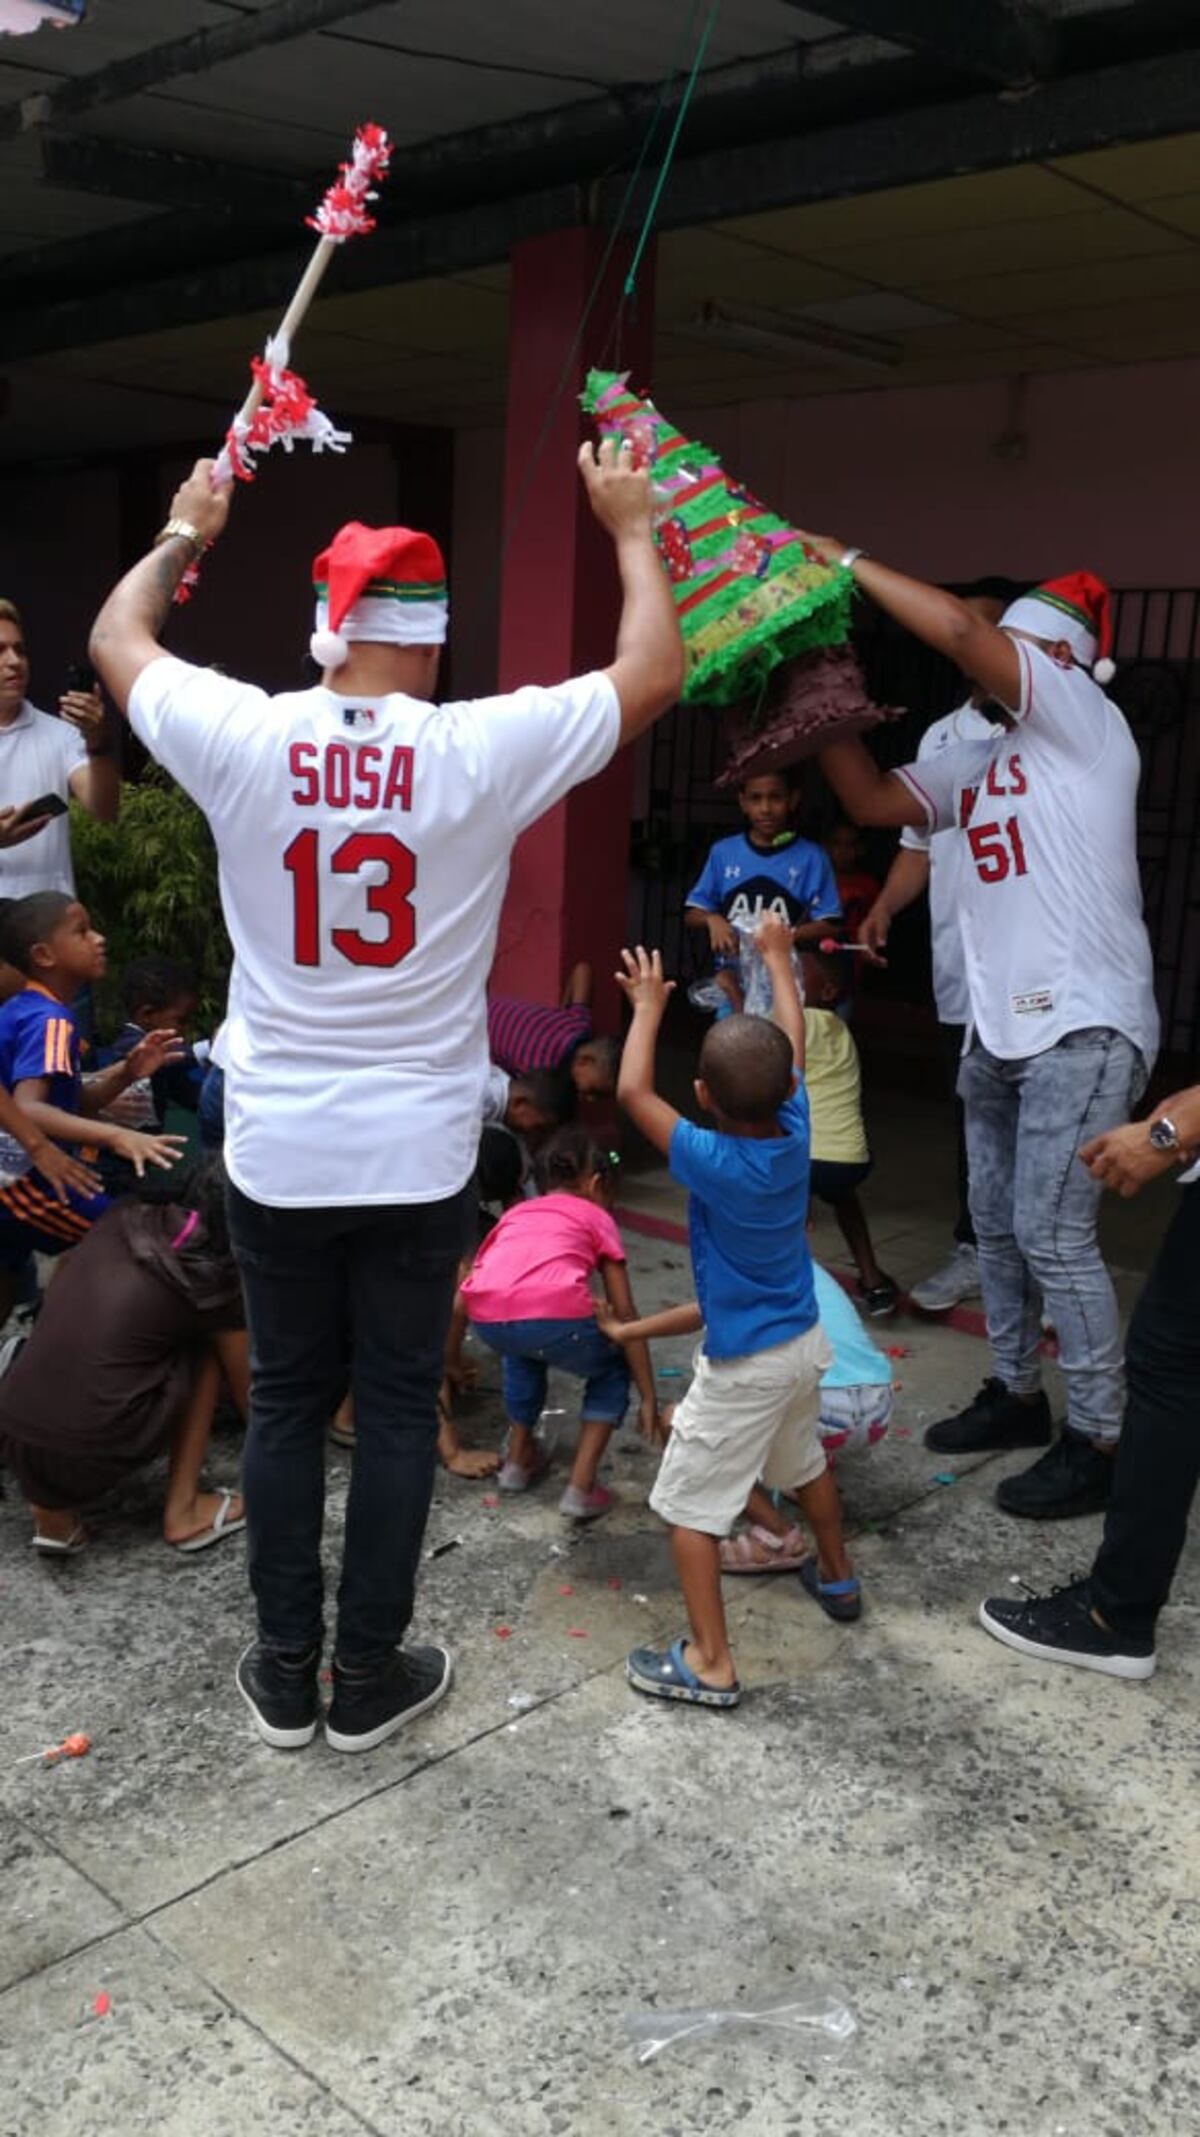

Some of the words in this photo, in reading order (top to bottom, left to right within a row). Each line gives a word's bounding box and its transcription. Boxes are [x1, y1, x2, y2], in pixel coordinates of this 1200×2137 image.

[288, 742, 415, 812] SOSA
[967, 816, 1028, 884] 51
[283, 828, 417, 968] 13
[727, 892, 791, 927] AIA
